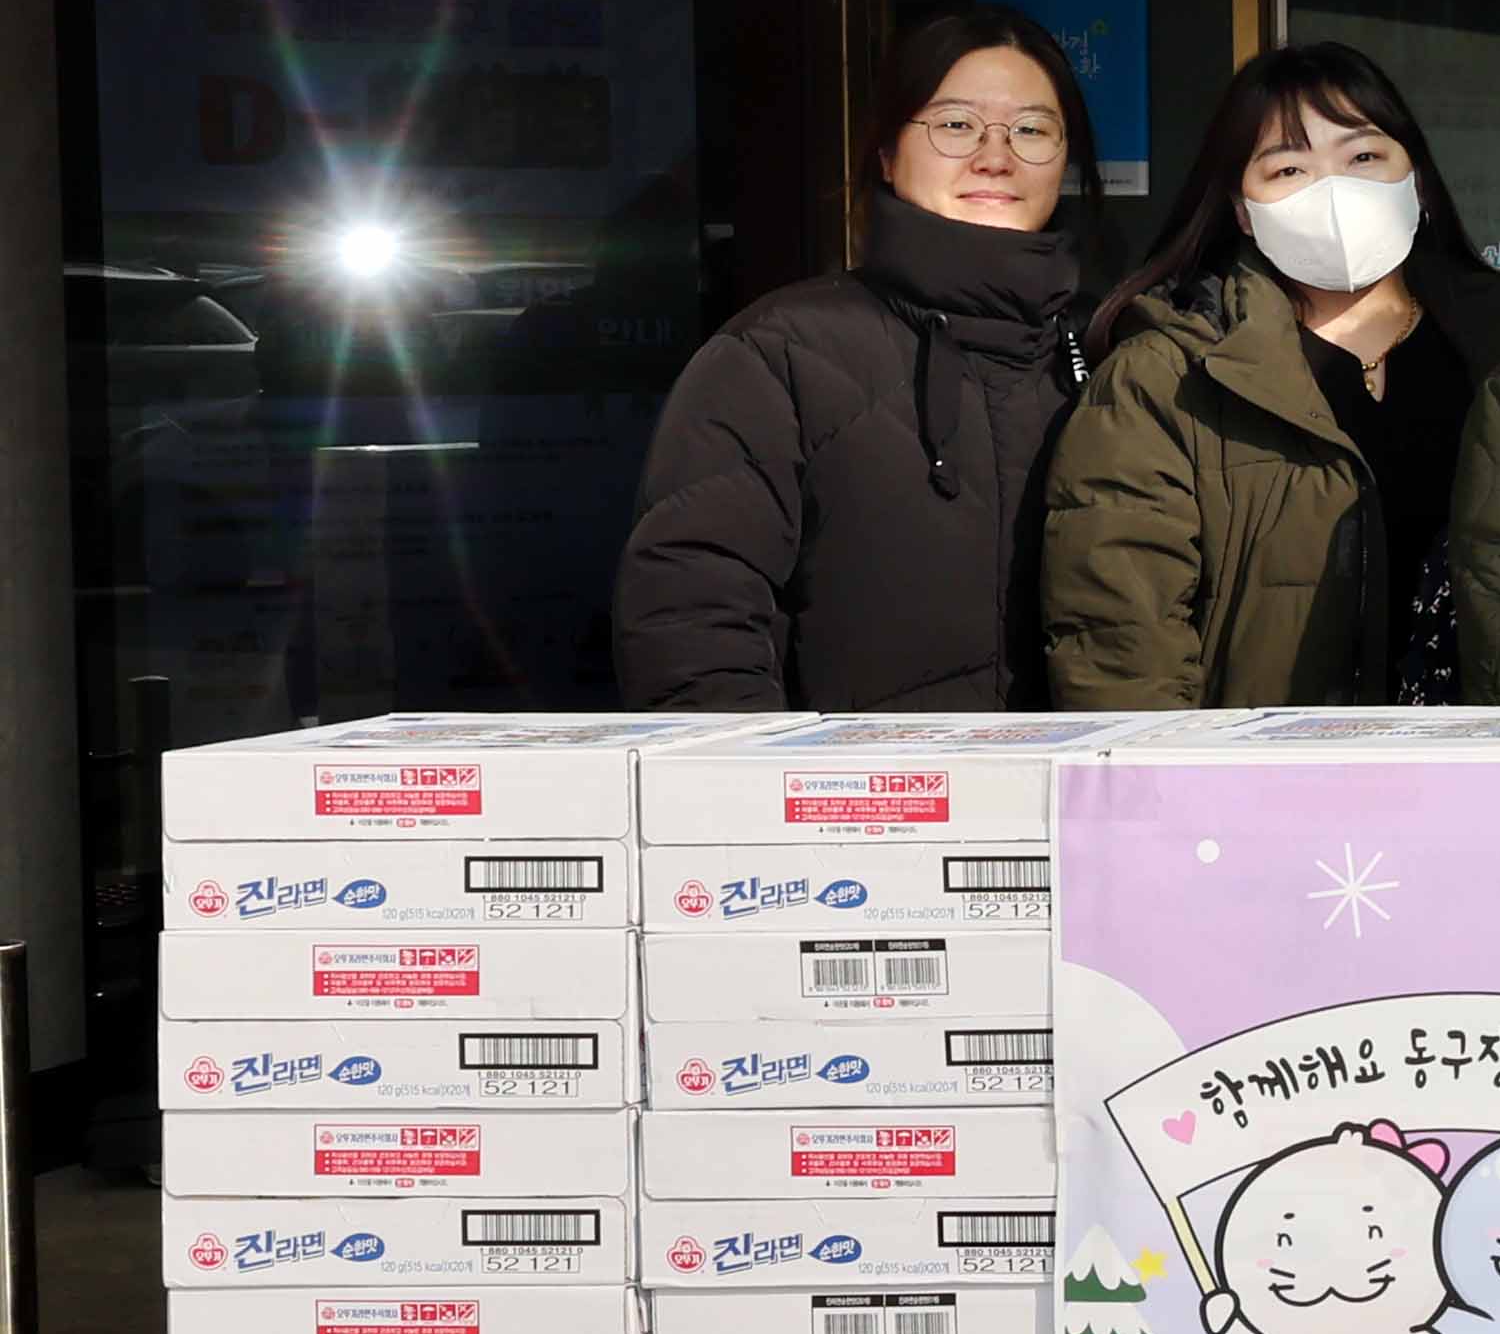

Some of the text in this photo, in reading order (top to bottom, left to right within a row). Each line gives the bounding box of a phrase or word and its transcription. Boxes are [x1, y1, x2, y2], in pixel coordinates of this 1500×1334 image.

[235, 876, 381, 920] 진라면 순한맛
[488, 903, 576, 919] 52 121
[719, 877, 861, 920] 진라면 순한맛
[1199, 1040, 1387, 1129] 함께해요
